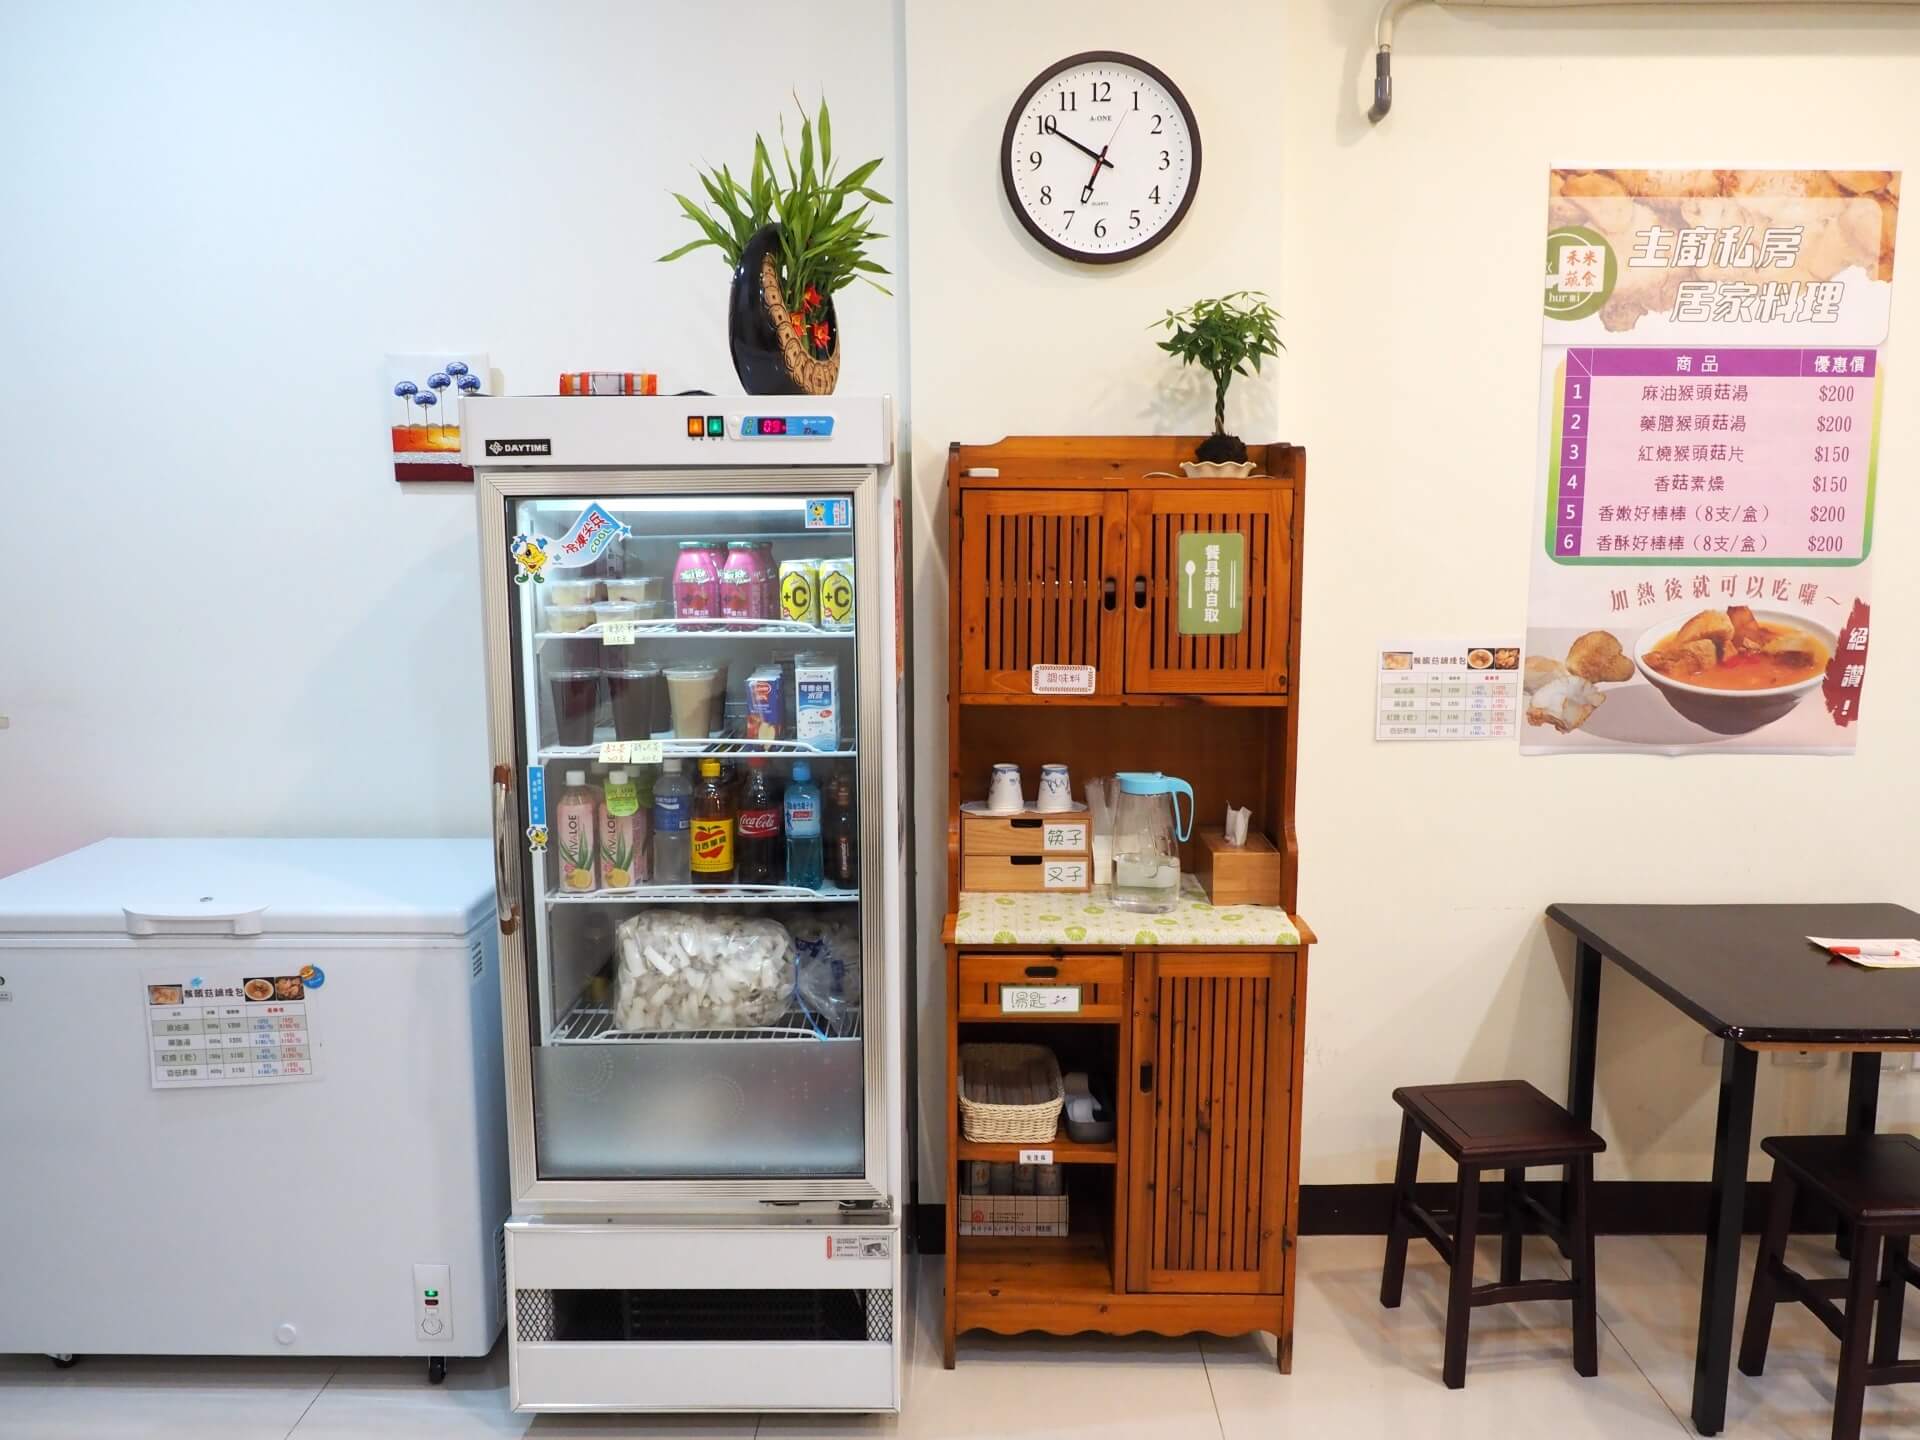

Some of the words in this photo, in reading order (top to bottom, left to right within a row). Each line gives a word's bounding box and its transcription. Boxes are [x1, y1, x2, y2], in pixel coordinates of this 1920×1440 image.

[1059, 91, 1078, 111] 11
[1091, 82, 1112, 102] 12
[1132, 91, 1140, 111] 1
[1037, 115, 1057, 135] 10
[1150, 115, 1163, 134] 2
[1030, 151, 1042, 171] 9
[1158, 151, 1170, 170] 3
[1040, 186, 1052, 205] 8
[1148, 185, 1161, 204] 4
[1063, 210, 1075, 230] 7
[1094, 218, 1106, 238] 6
[1129, 210, 1141, 229] 5
[1628, 225, 1804, 269] 主廚私房
[1669, 281, 1845, 323] 居家料理
[1676, 355, 1719, 372] 商品
[1814, 355, 1865, 373] 優惠價
[1572, 385, 1582, 399] 1
[1641, 384, 1748, 402] 麻油猴頭菇湯
[1819, 384, 1854, 402] $200
[1571, 415, 1581, 430] 2
[1639, 414, 1746, 432] 藥膳猴頭菇湯
[1817, 416, 1852, 432] $200
[504, 444, 549, 452] DAYTIME
[1569, 445, 1579, 460] 3
[1638, 444, 1744, 463] 紅燒猴頭菇片
[1814, 446, 1849, 463] $150
[1567, 475, 1577, 489] 4
[1812, 476, 1847, 493] $150
[1566, 505, 1575, 519] 5
[1810, 506, 1845, 522] $200
[591, 527, 614, 554] COOL
[1564, 534, 1574, 549] 6
[1808, 536, 1843, 552] $200
[1204, 544, 1220, 622] 餐具請自取
[1048, 829, 1083, 846] 筷子
[1048, 866, 1083, 882] 叉子
